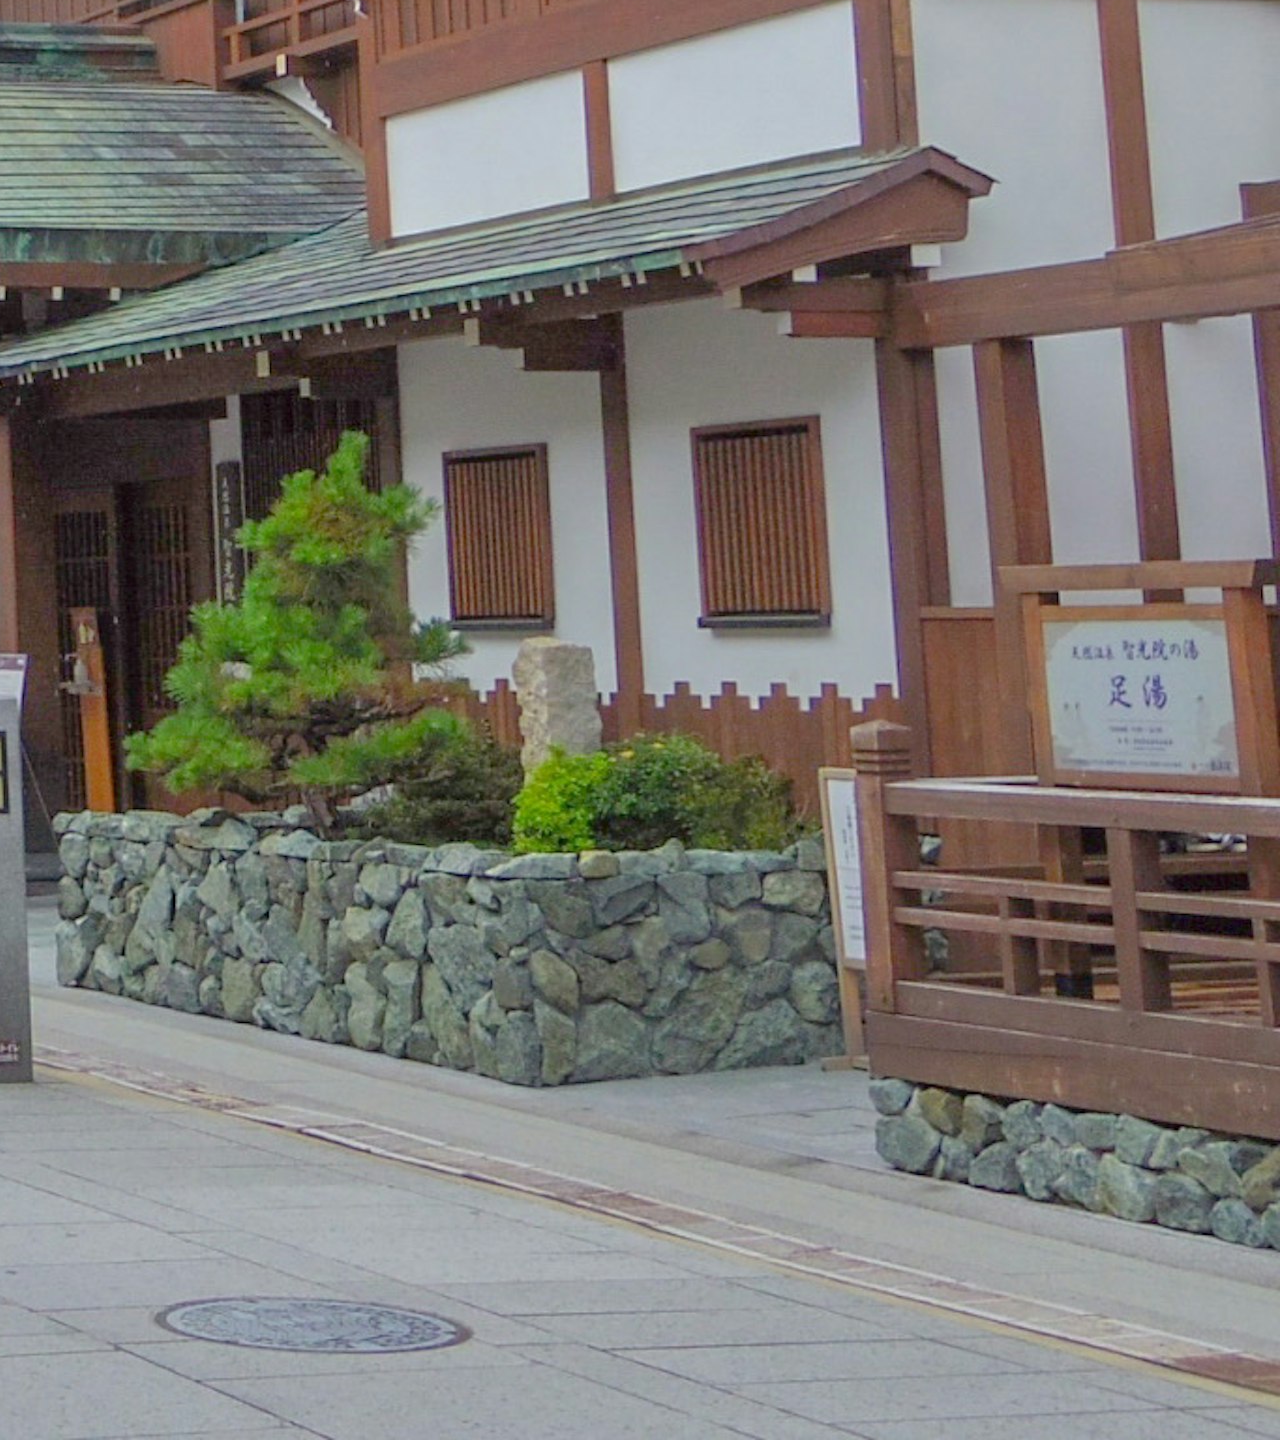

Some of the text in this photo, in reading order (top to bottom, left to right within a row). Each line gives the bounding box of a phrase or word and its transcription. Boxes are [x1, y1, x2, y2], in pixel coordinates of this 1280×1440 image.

[1122, 639, 1199, 661] 智光院の湯
[1107, 674, 1169, 710] 足湯
